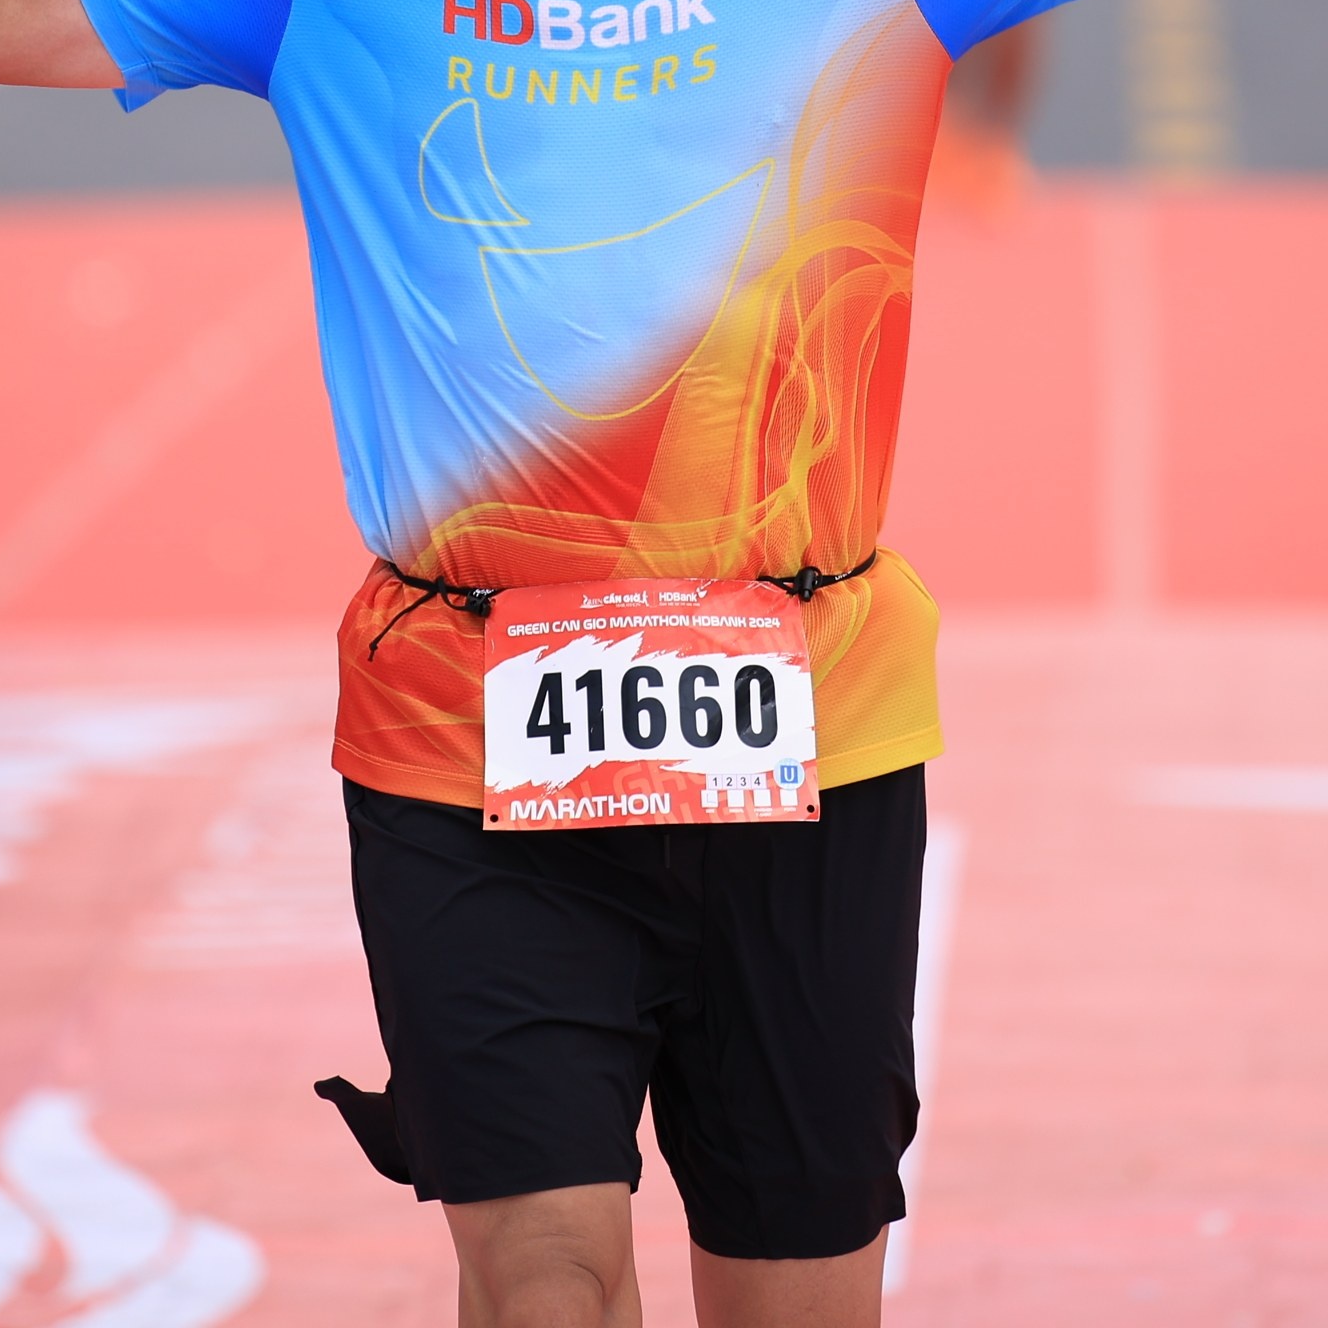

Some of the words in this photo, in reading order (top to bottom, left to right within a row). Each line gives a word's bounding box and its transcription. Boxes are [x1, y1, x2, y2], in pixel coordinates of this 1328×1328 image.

[447, 43, 719, 105] RUNNERS
[658, 591, 698, 603] HDBank
[507, 621, 550, 638] GREEN
[552, 619, 581, 633] CAN
[583, 616, 608, 631] GIO
[609, 614, 690, 629] MARATHON
[692, 615, 747, 628] HDBANK
[748, 616, 782, 629] 2024
[526, 664, 779, 756] 41660
[726, 776, 733, 787] 2
[740, 776, 747, 787] 3
[753, 776, 761, 787] 4
[510, 792, 672, 821] MARATHON
